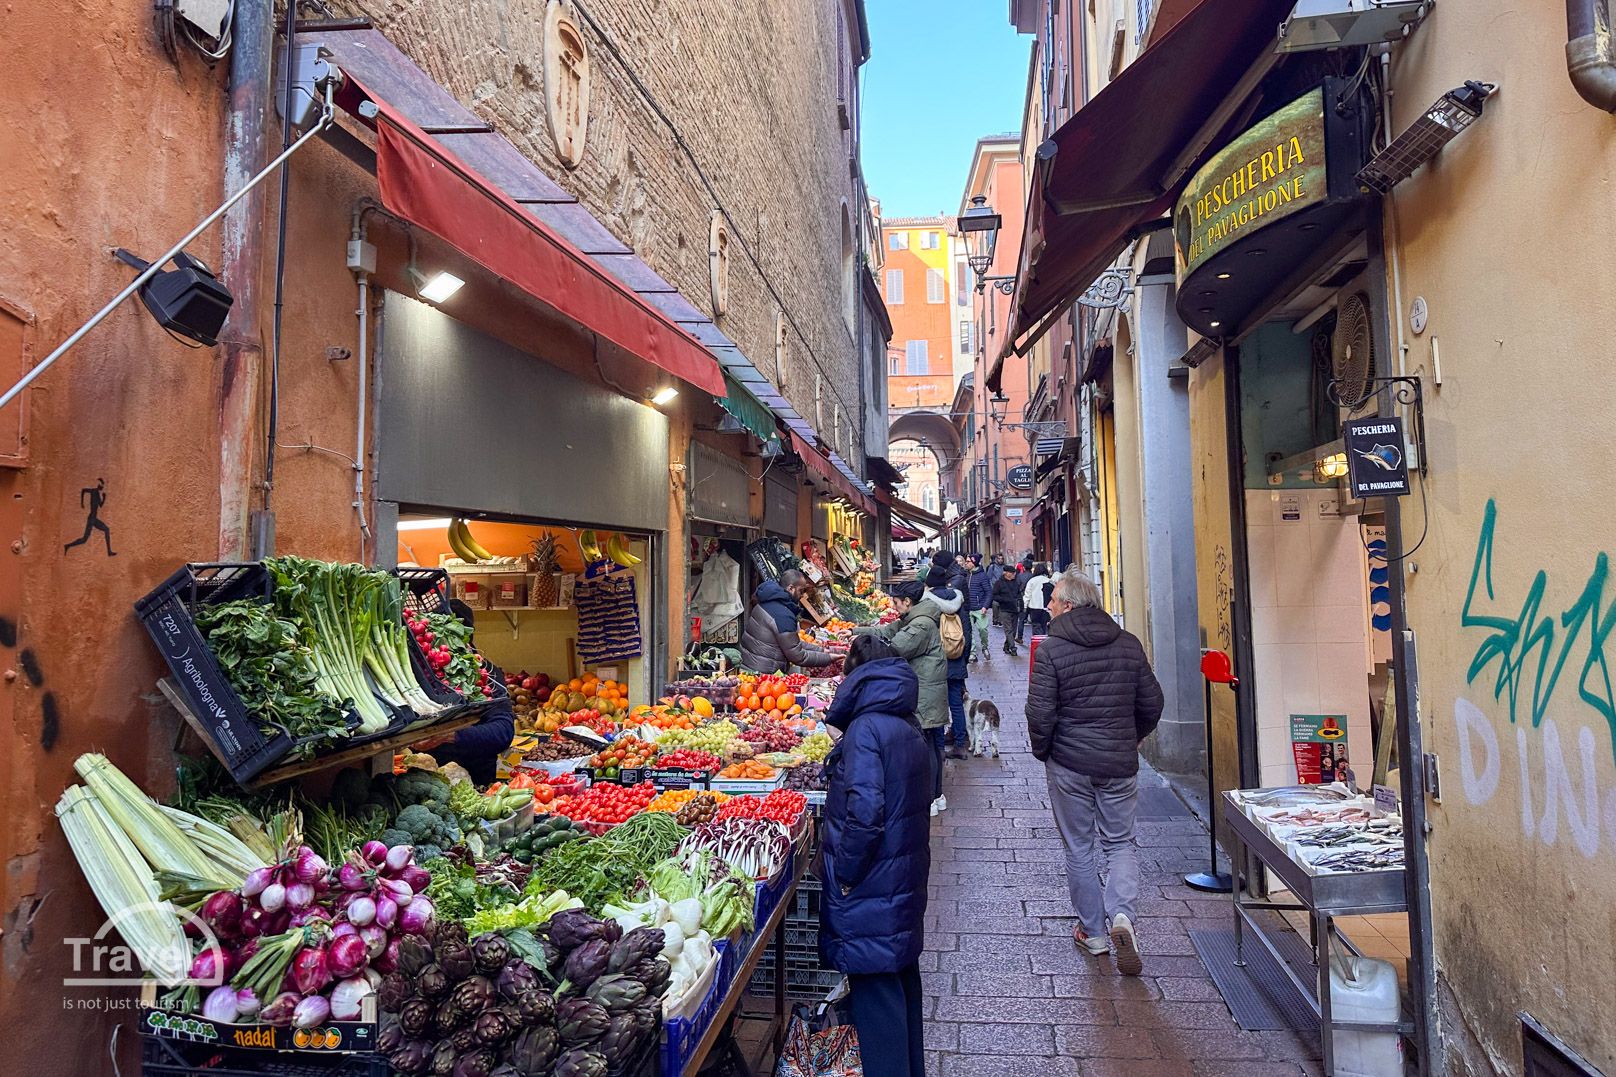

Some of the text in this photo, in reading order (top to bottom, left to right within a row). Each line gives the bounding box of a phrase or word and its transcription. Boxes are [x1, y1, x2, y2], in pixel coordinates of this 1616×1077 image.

[1196, 136, 1305, 226] PESCHERIA
[1189, 174, 1306, 262] DEL PAVAGLIONE
[1352, 424, 1396, 435] PESCHERIA
[1358, 480, 1404, 491] DEL PAVAGLIONE
[163, 614, 181, 635] 7207
[182, 658, 219, 712] Agribologna
[233, 1026, 276, 1049] nadal
